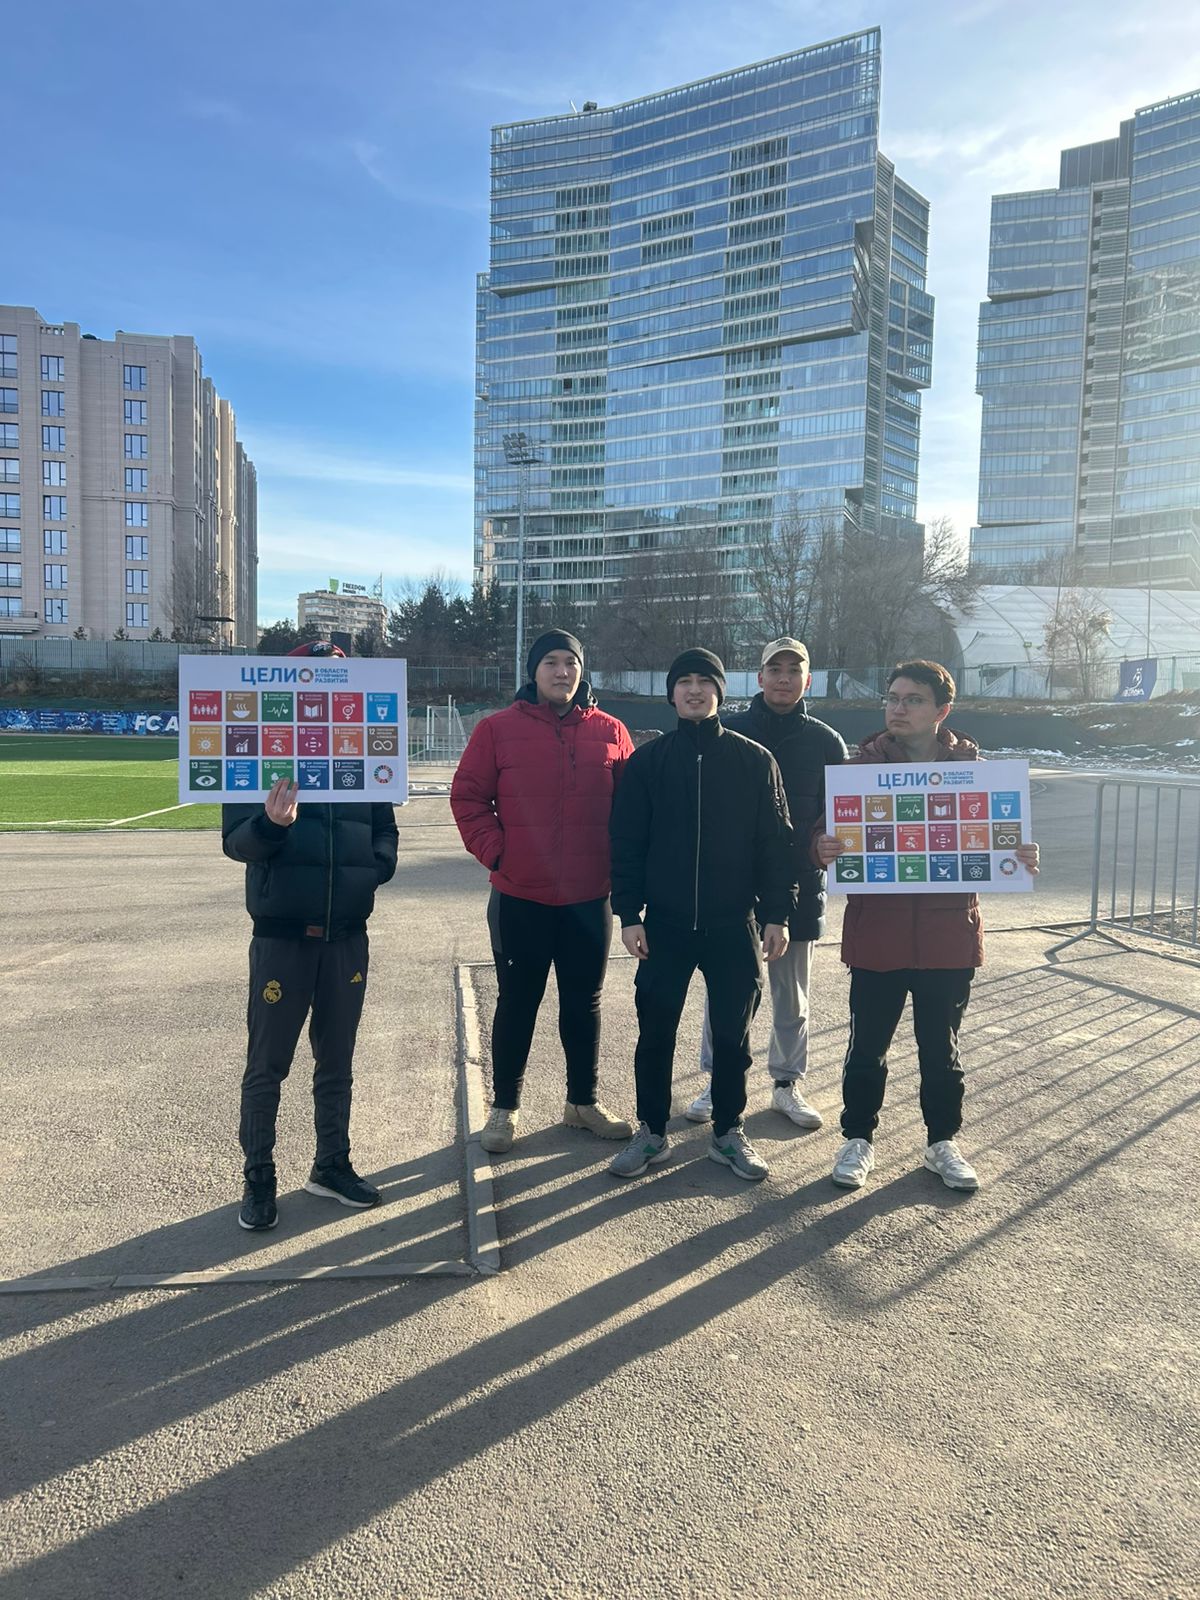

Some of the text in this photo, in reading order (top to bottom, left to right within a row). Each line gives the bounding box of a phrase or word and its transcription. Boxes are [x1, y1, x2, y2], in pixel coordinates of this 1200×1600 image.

[342, 582, 366, 591] FREEDOM
[241, 667, 297, 685] ЦЕЛИ
[134, 715, 161, 731] FC
[878, 772, 927, 790] ЦЕЛИ
